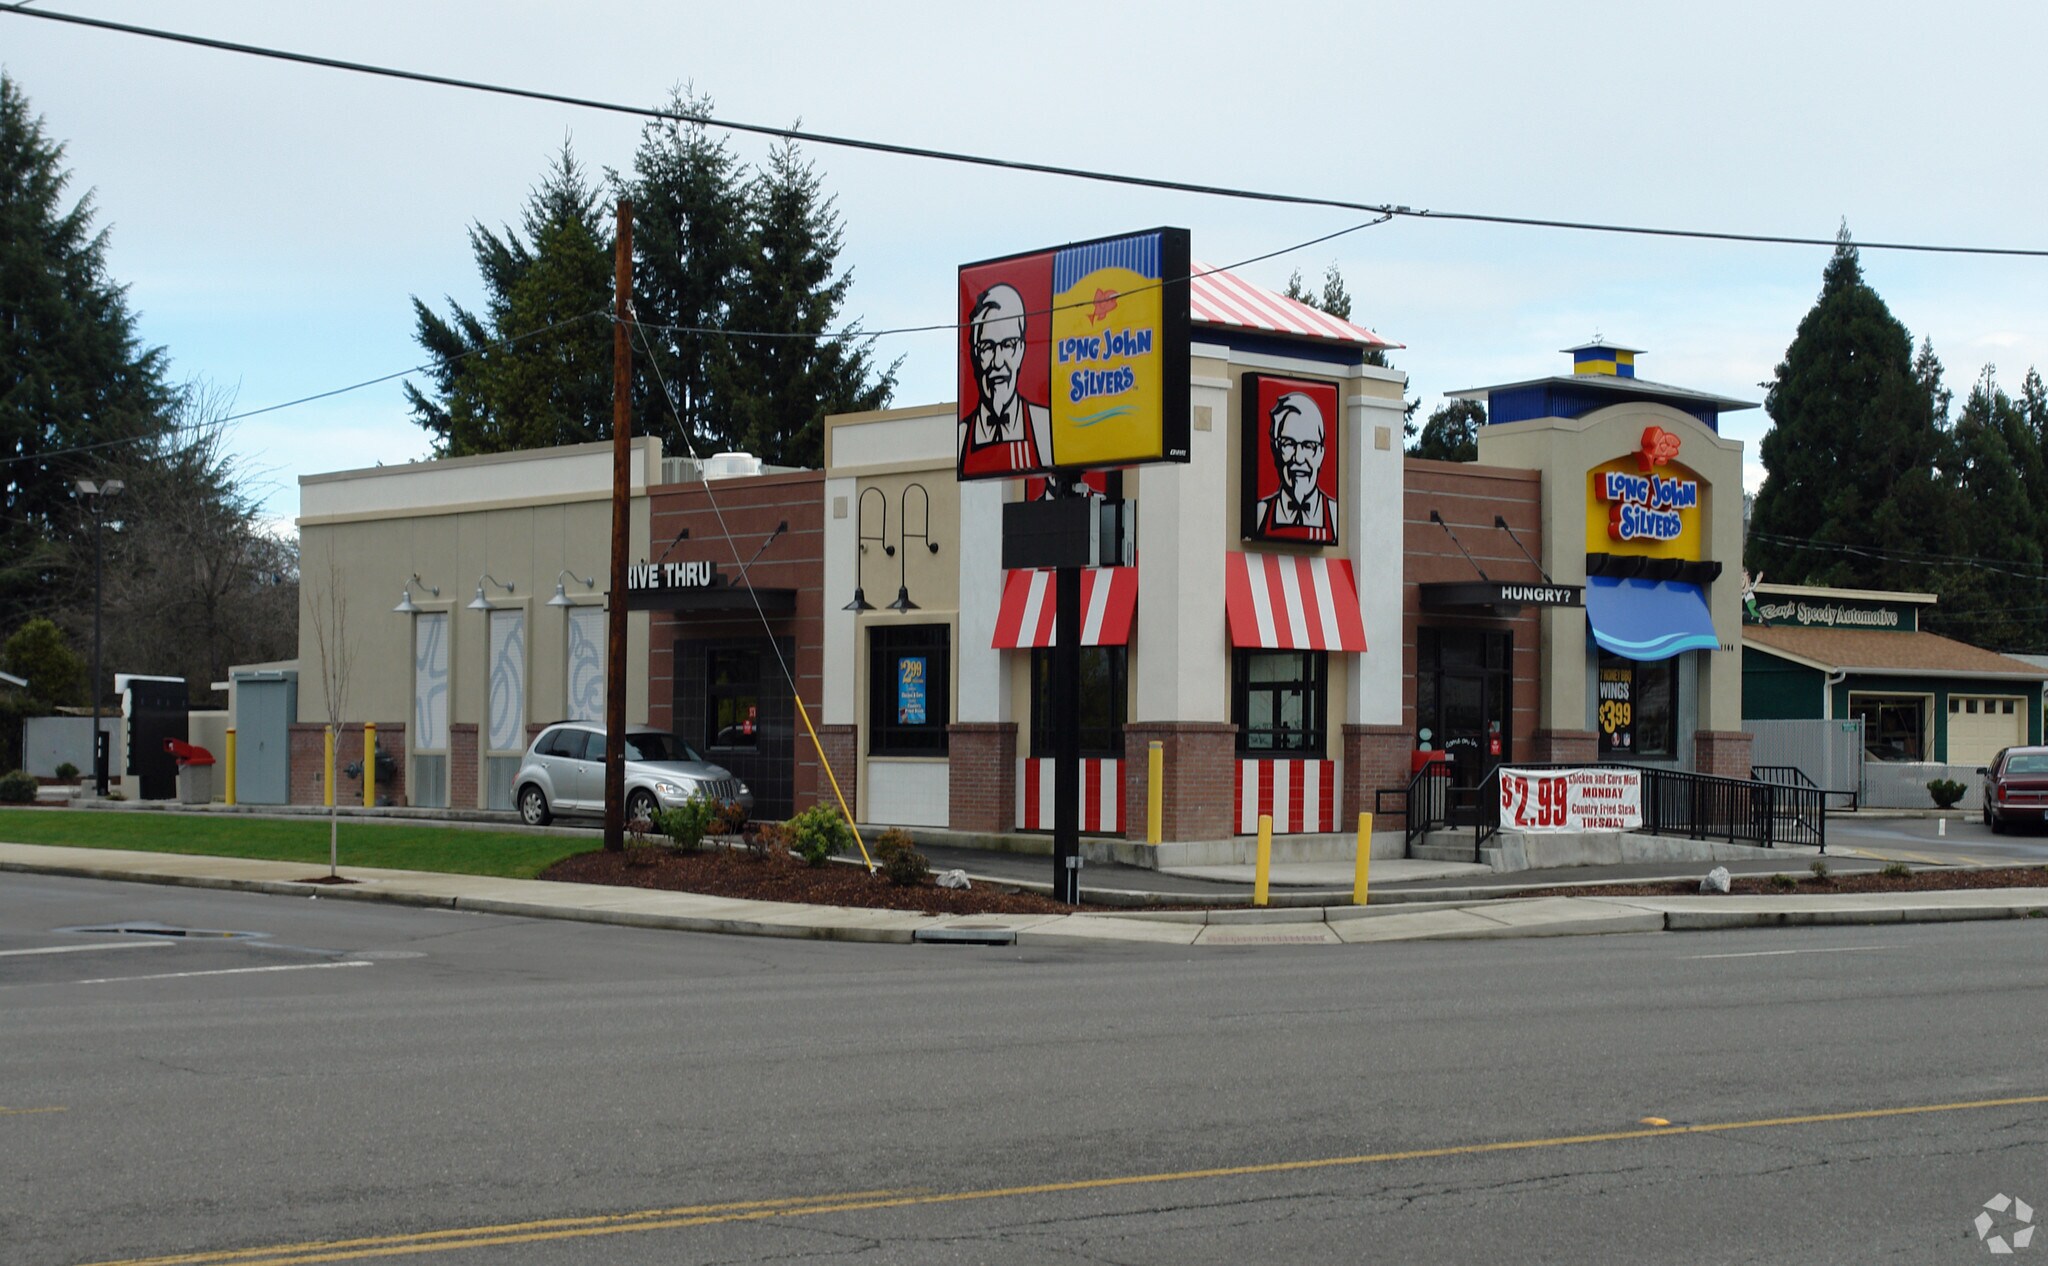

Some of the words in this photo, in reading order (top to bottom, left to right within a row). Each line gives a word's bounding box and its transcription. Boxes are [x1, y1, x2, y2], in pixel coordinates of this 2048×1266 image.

[664, 561, 711, 588] THRU
[1501, 586, 1571, 603] HUNGRY?
[1797, 602, 1836, 626] Speedy
[1835, 605, 1898, 626] Automotive
[1600, 682, 1630, 700] WINGS
[1568, 773, 1593, 785] Chicken
[1594, 774, 1606, 785] and
[1501, 775, 1567, 827] $2.99
[1582, 787, 1624, 799] MONDAY
[1571, 803, 1598, 816] Country
[1600, 803, 1616, 815] Fried
[1617, 804, 1636, 816] Steak
[1582, 817, 1625, 829] TUESDAY
